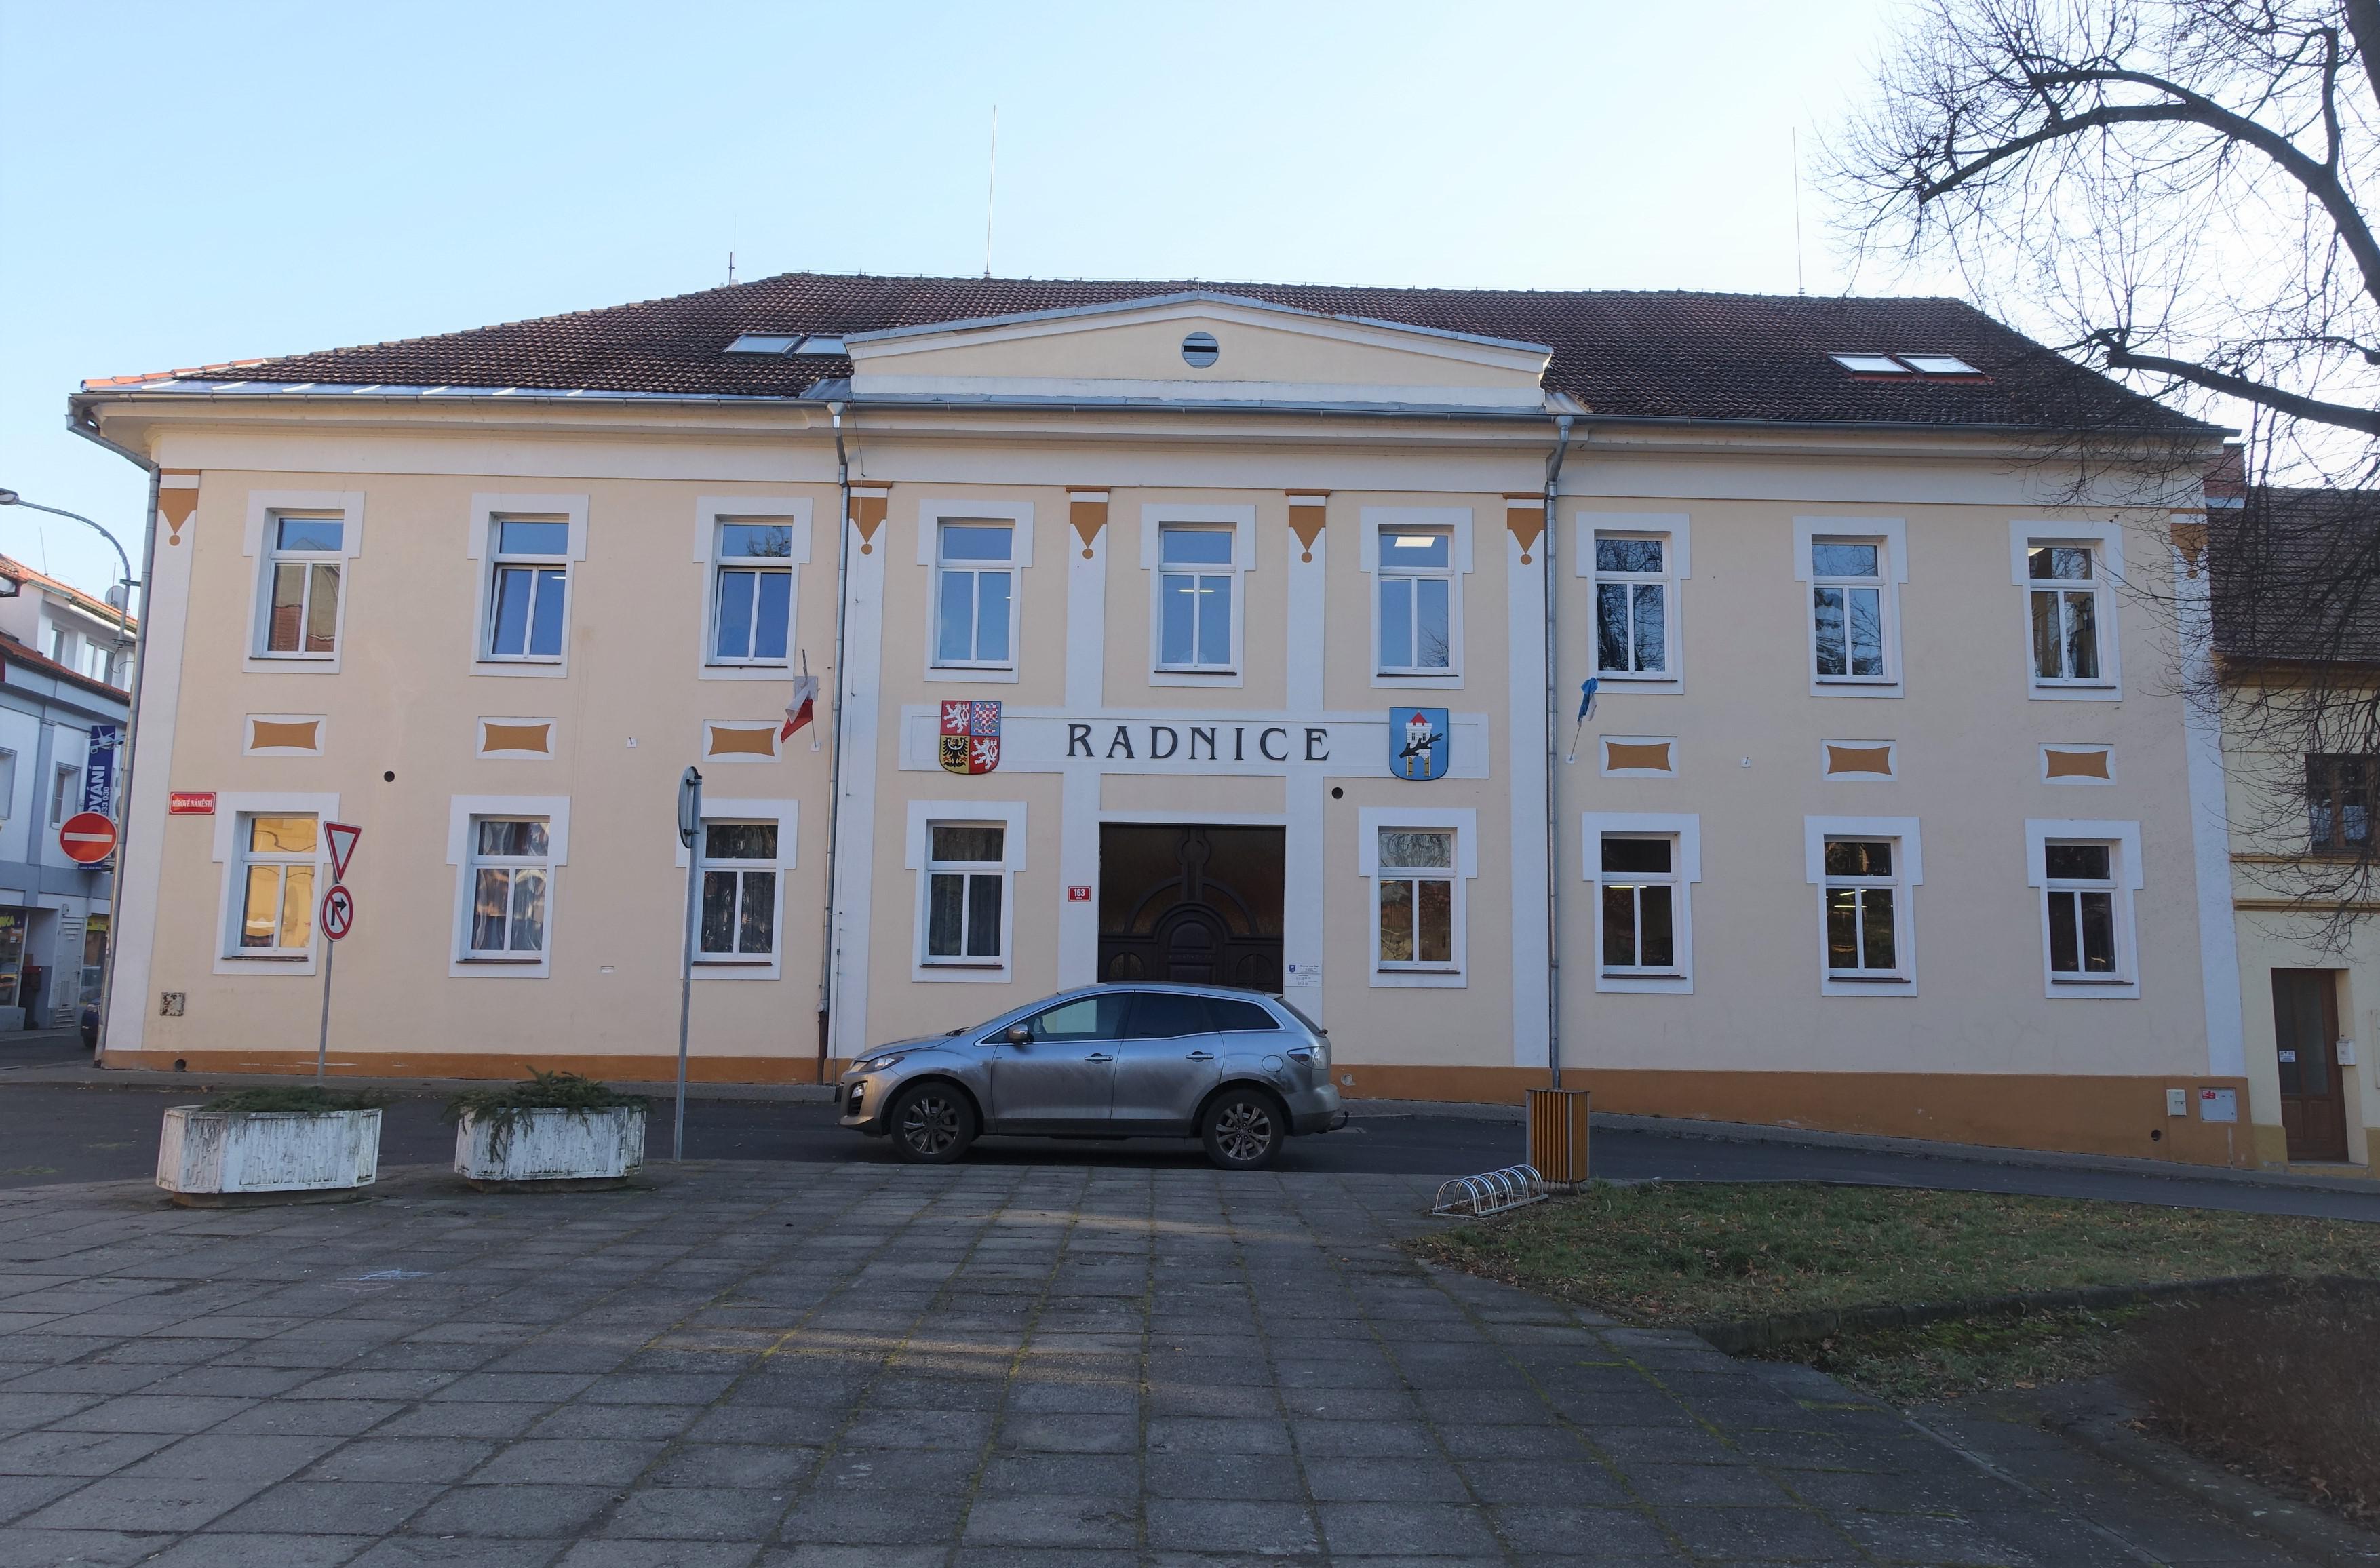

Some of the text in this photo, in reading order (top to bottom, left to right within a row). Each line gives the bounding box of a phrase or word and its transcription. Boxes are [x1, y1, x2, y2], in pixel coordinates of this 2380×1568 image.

[1066, 724, 1330, 761] RADNICE
[191, 798, 214, 807] NÁMĚSTÍ
[1074, 888, 1085, 897] 163
